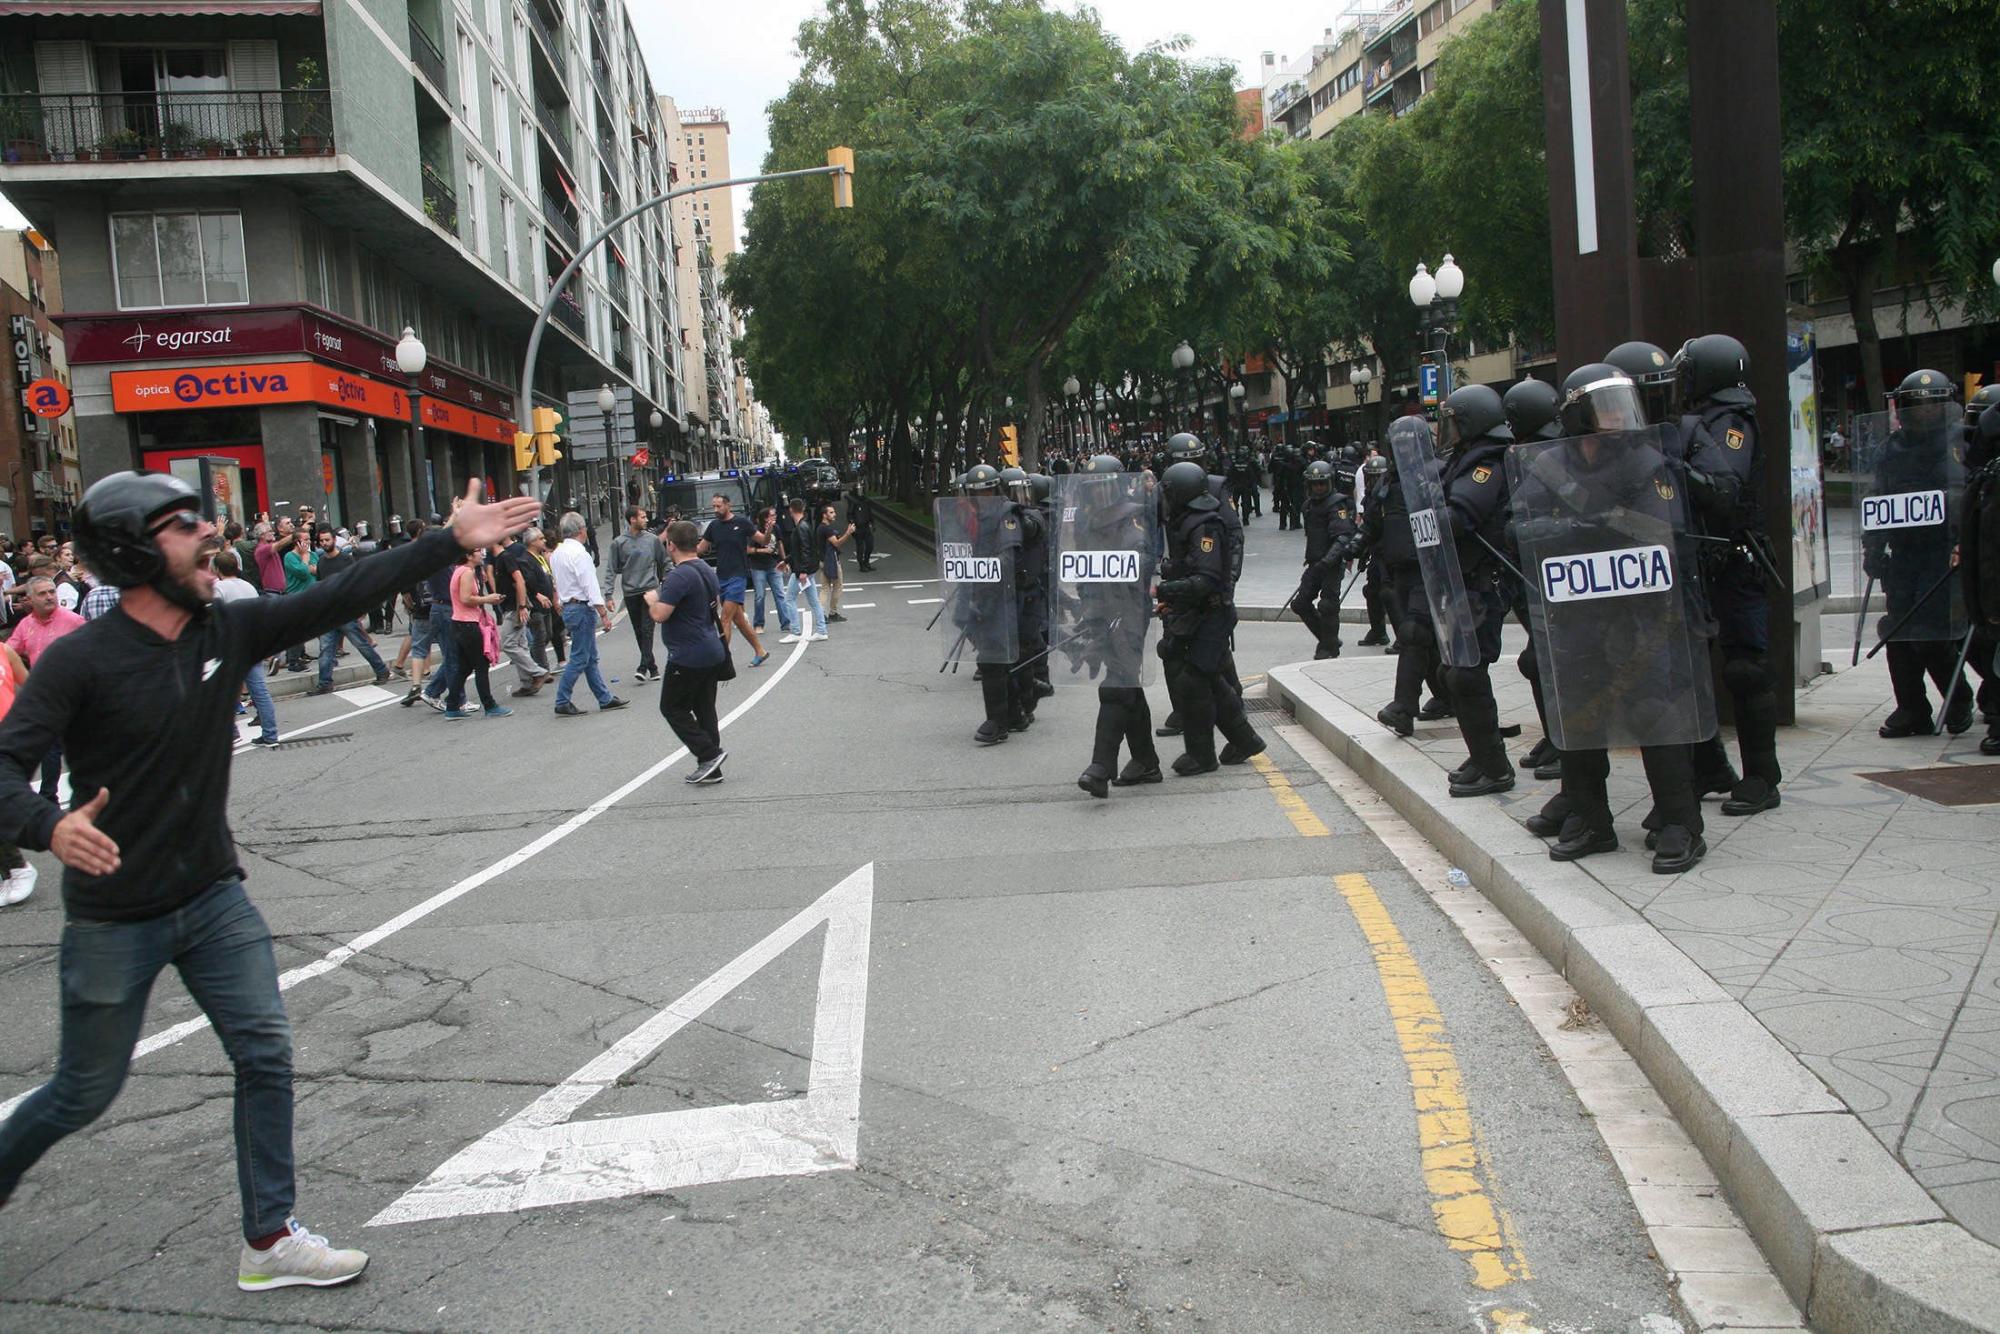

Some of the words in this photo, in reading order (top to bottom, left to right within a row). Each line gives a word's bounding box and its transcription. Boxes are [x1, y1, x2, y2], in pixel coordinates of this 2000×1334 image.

[156, 327, 232, 350] egarsat
[135, 385, 171, 397] òptica
[174, 371, 289, 402] activa
[1864, 494, 1943, 526] POLICIA
[945, 559, 1000, 580] POLICIA
[1062, 554, 1137, 579] POLICIA
[1545, 550, 1671, 597] POLICIA
